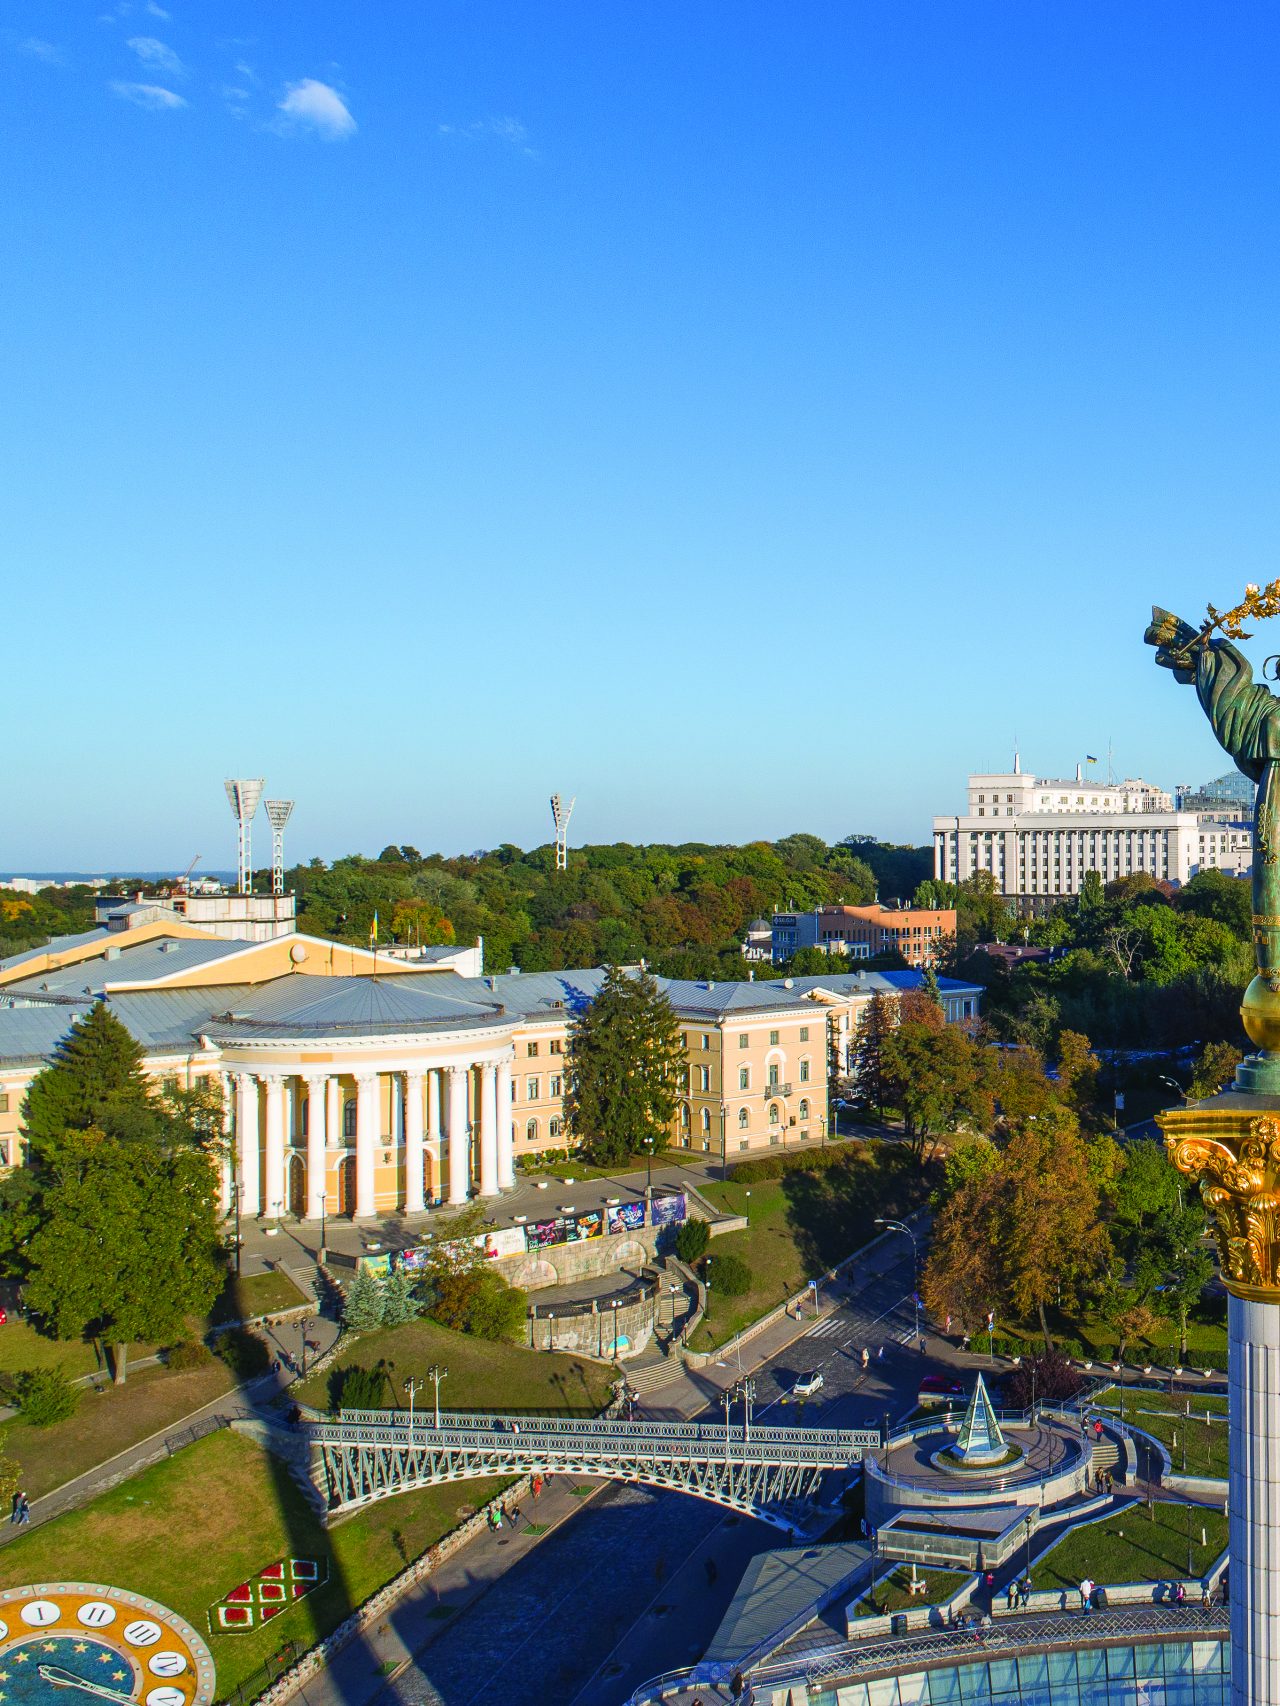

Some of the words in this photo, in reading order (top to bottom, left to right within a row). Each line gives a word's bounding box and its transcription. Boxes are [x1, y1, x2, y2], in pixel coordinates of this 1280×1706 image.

[87, 1607, 106, 1622] II
[128, 1624, 157, 1643] III
[157, 1656, 178, 1673] IV
